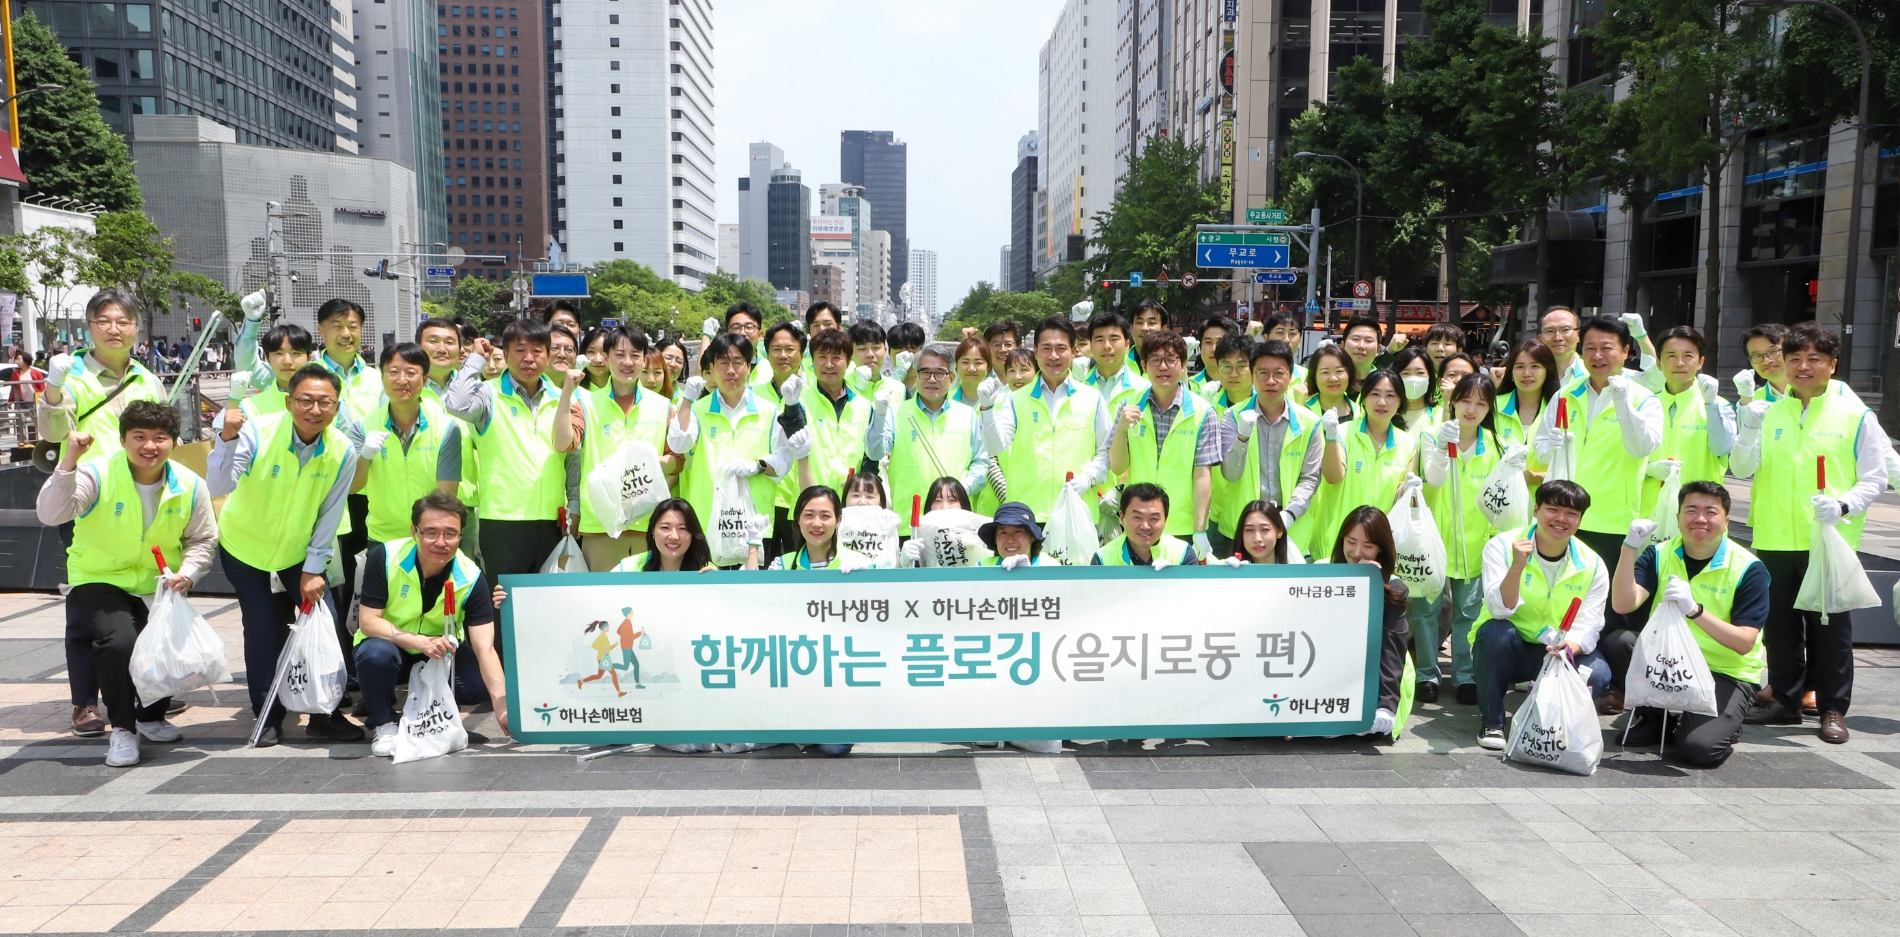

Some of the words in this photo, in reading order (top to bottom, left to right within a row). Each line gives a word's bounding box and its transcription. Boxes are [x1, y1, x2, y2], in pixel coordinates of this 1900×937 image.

[1224, 57, 1234, 86] BAR
[1221, 171, 1231, 200] 고바우
[1208, 234, 1221, 242] 광교
[1266, 235, 1279, 243] 시청
[1229, 247, 1257, 258] 무교로
[1289, 585, 1357, 598] 하나금융그룹
[806, 599, 889, 623] 하나생명
[905, 600, 919, 618] X
[932, 596, 1060, 621] 하나손해보험
[691, 634, 887, 689] 함께하는
[1289, 697, 1350, 714] 하나생명
[559, 707, 643, 724] 하나손해보험
[1521, 731, 1566, 753] PLASTIC
